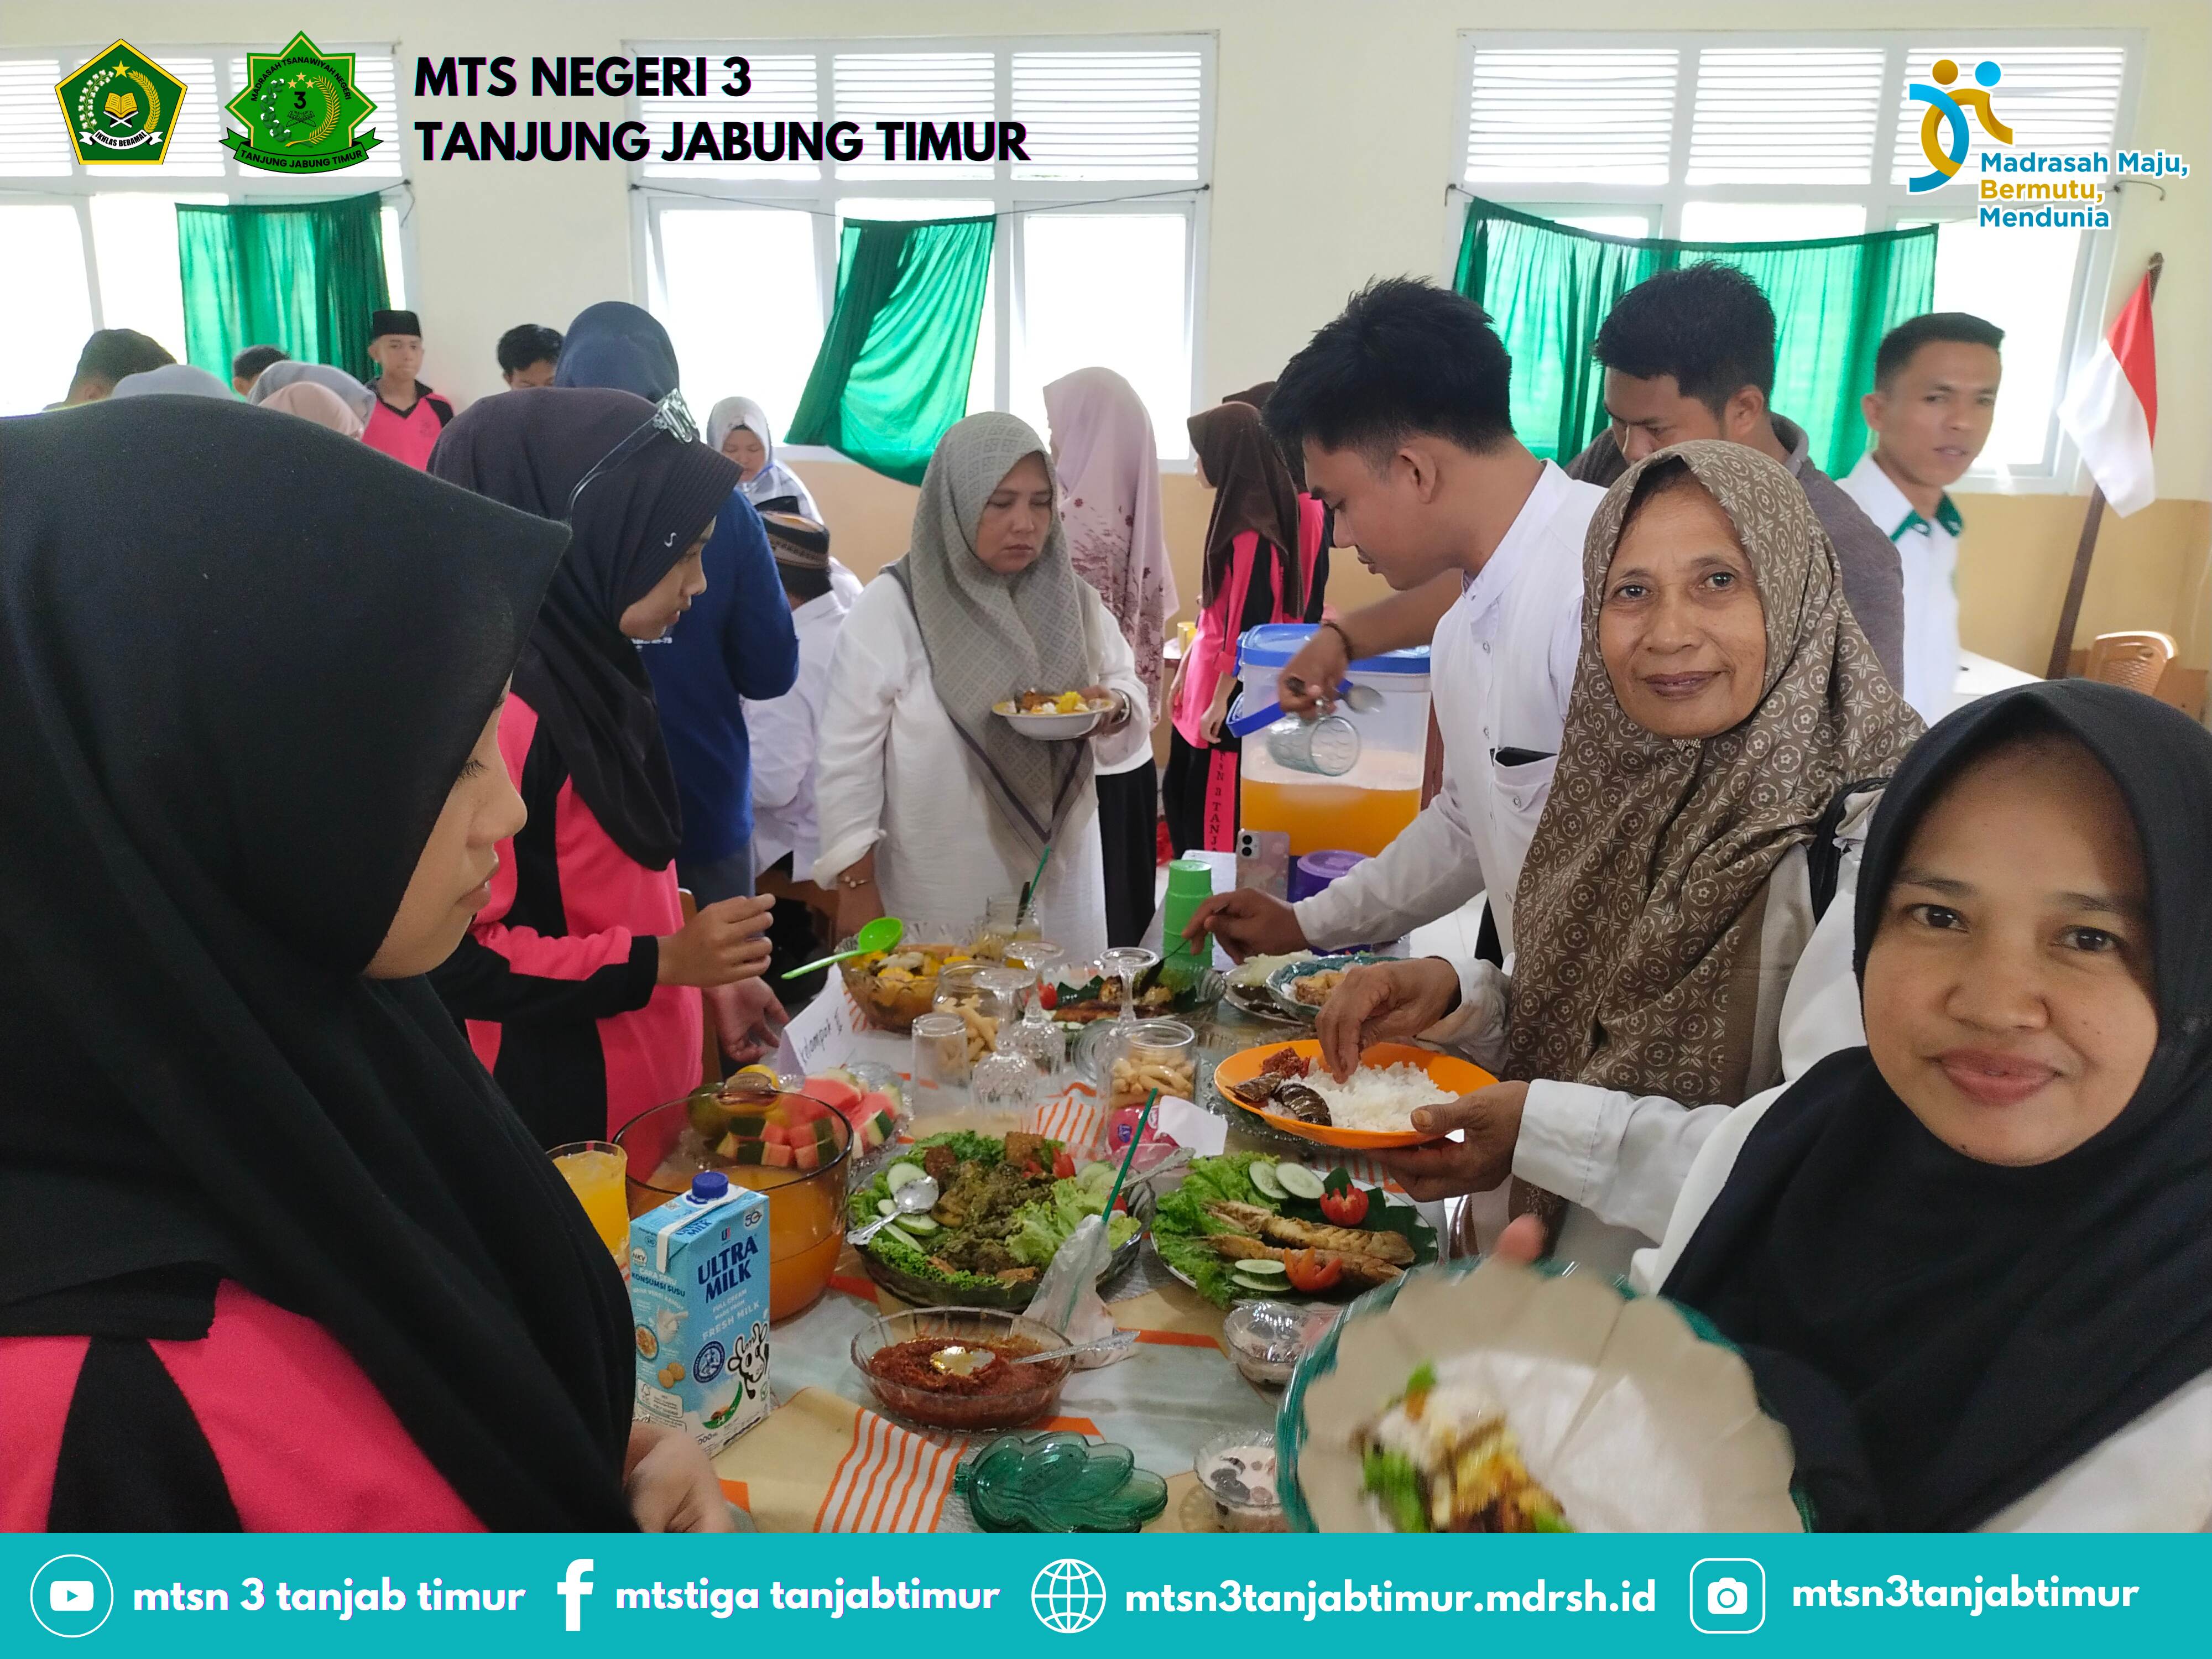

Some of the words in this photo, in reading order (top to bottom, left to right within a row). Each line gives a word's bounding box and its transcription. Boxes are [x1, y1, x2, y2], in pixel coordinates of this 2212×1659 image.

[698, 1235, 759, 1285] ULTRA
[706, 1259, 752, 1303] MILK
[667, 1285, 686, 1297] SUSU
[702, 1316, 734, 1341] FRESH
[737, 1301, 760, 1319] MILK
